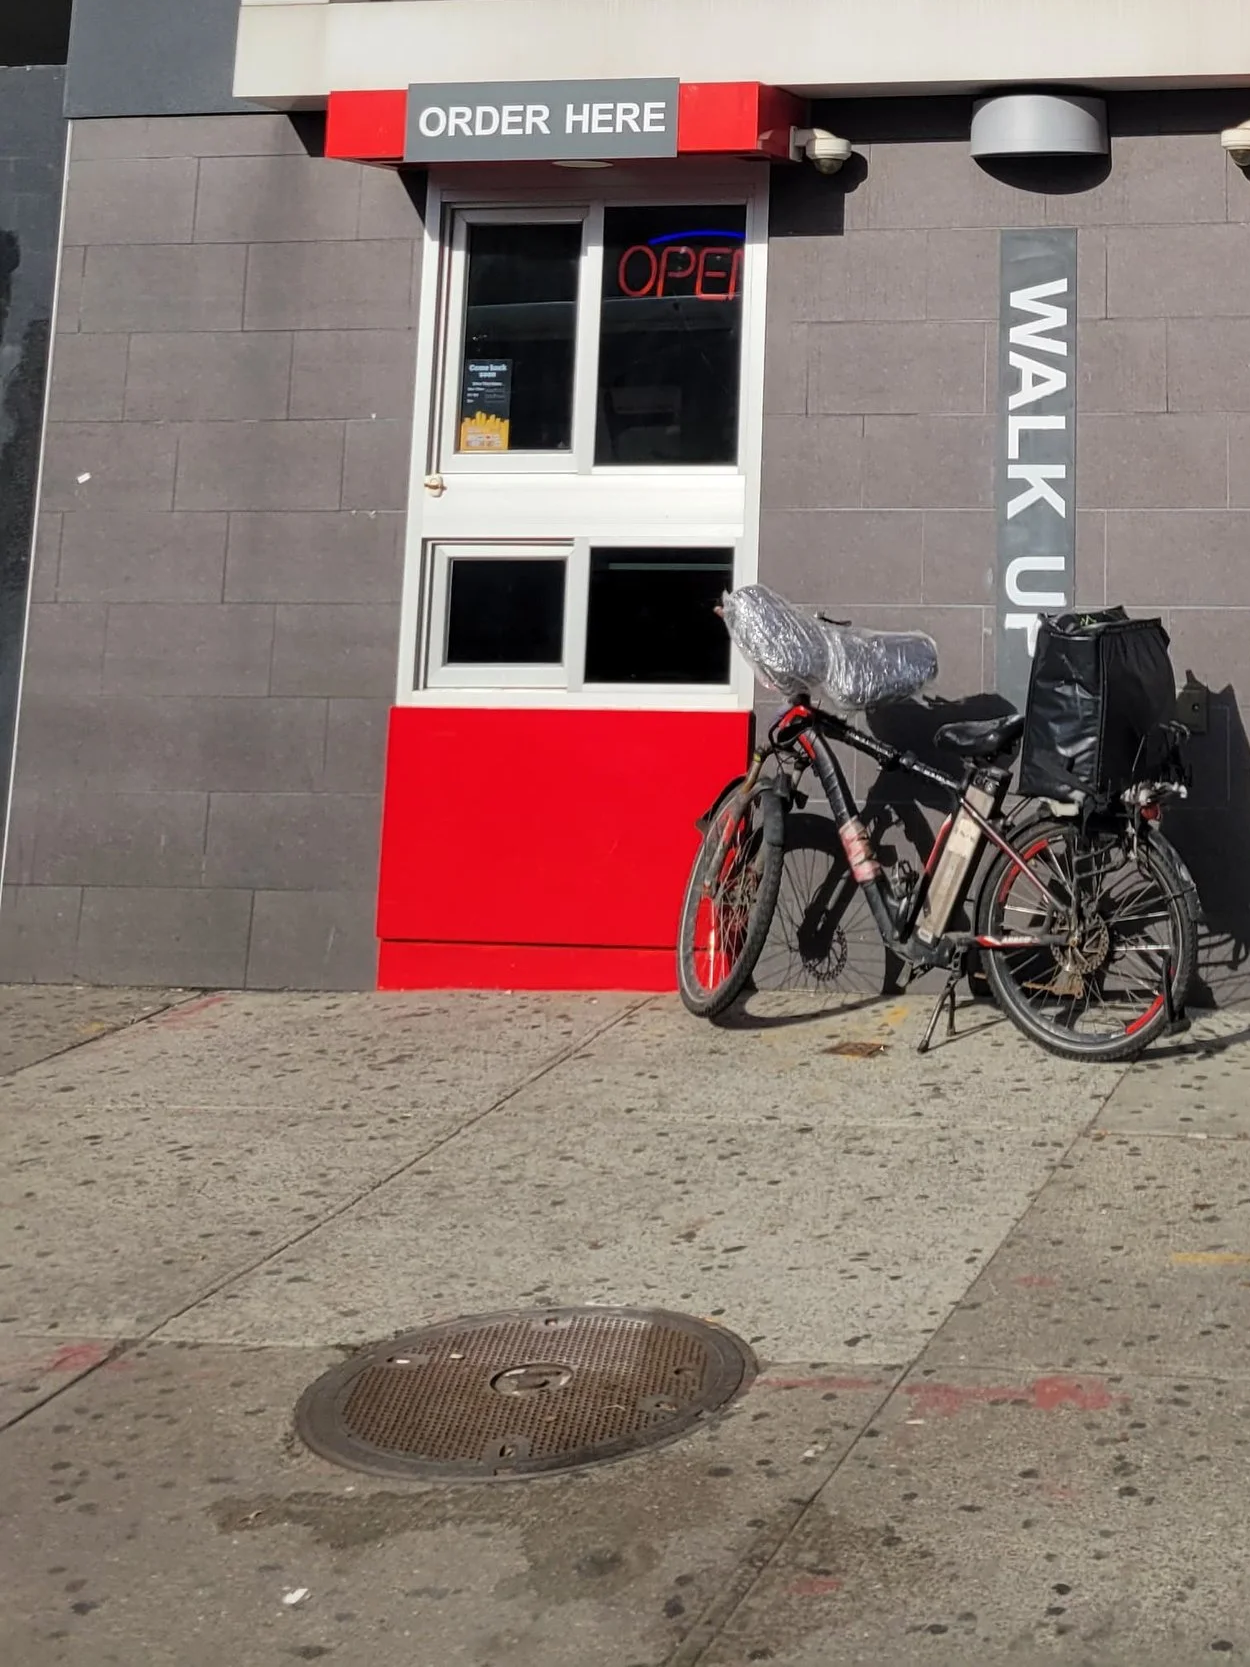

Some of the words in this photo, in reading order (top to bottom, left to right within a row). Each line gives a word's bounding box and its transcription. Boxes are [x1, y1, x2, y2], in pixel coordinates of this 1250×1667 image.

[418, 104, 551, 137] ORDER
[565, 101, 666, 134] HERE
[1007, 277, 1068, 520] WALK
